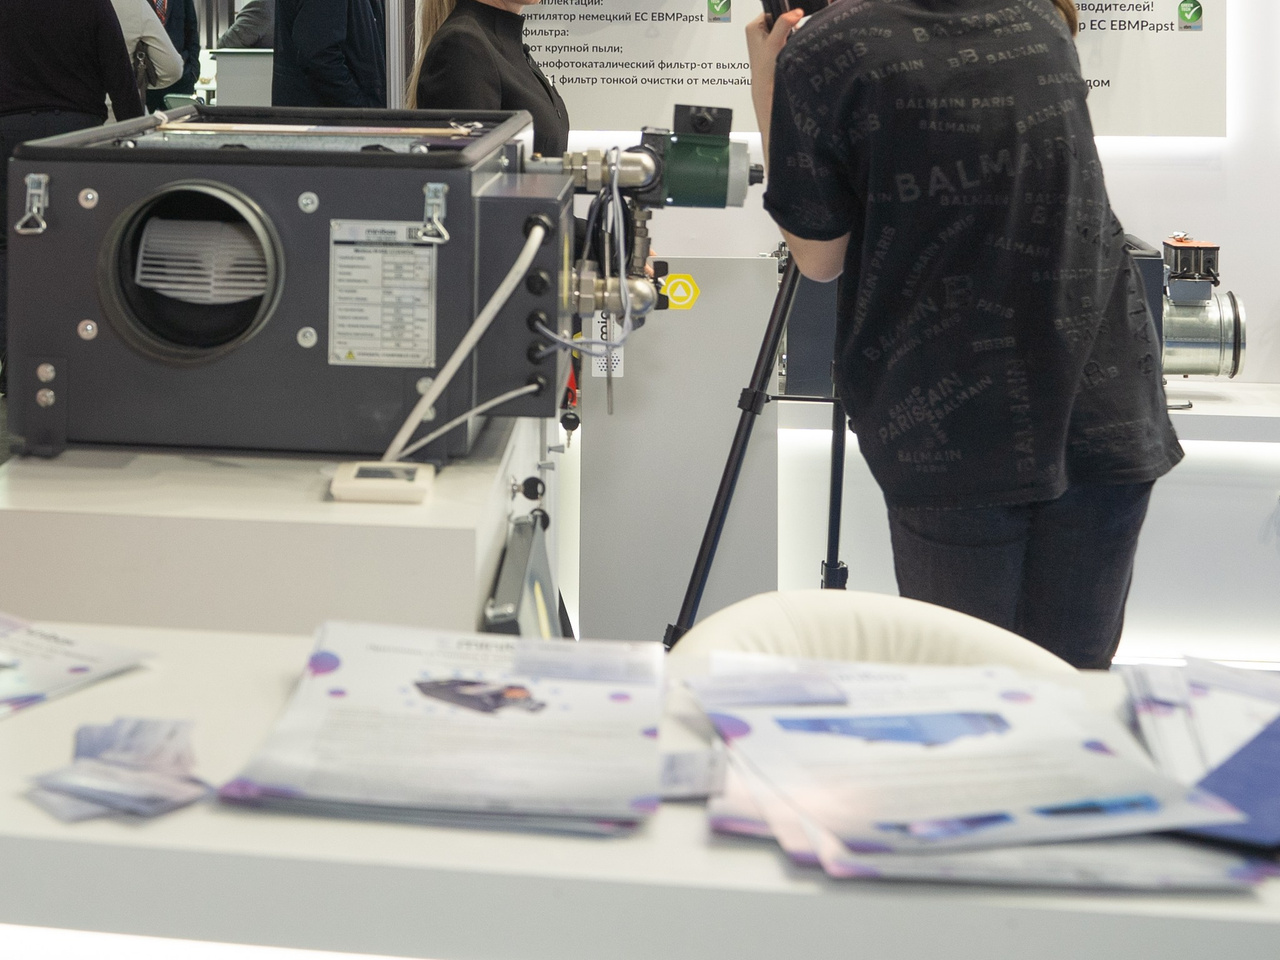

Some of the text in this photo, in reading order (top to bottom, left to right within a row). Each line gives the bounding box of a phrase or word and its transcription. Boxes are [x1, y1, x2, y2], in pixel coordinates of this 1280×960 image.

[579, 12, 632, 23] немецкий
[634, 12, 648, 21] EC
[651, 12, 704, 23] EBMPapst
[522, 27, 569, 38] фильтра:
[1090, 20, 1106, 30] EC
[1110, 20, 1175, 33] EBMPapst
[545, 43, 589, 53] крупной
[592, 45, 623, 53] пыли;
[658, 60, 713, 70] фильтр-от
[716, 62, 751, 70] выхло
[810, 42, 868, 92] PARIS
[559, 75, 598, 85] фильтр
[601, 75, 638, 84] тонкой
[641, 77, 684, 85] очистки
[896, 95, 1016, 110] BALMAIN PARIS
[919, 119, 981, 133] BALMAIN
[871, 225, 896, 269] PARIS
